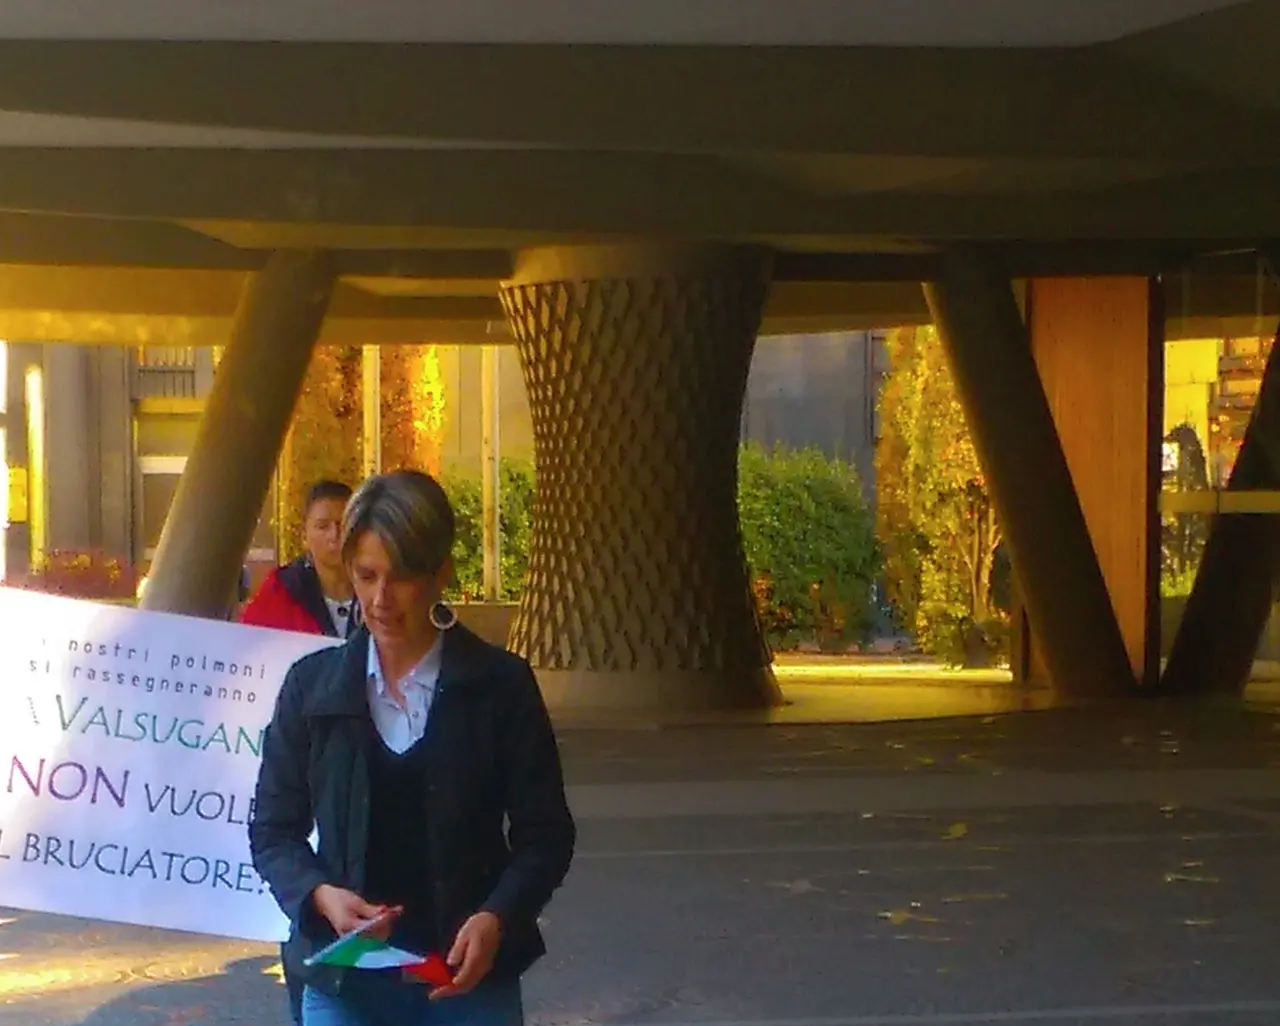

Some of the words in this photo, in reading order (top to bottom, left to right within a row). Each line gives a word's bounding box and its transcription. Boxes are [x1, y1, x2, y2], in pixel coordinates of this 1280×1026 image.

[68, 639, 150, 663] nostri
[170, 653, 266, 680] polmoni
[72, 664, 257, 704] rassegneranno
[55, 693, 264, 758] VALSUGAN
[6, 755, 130, 809] NON
